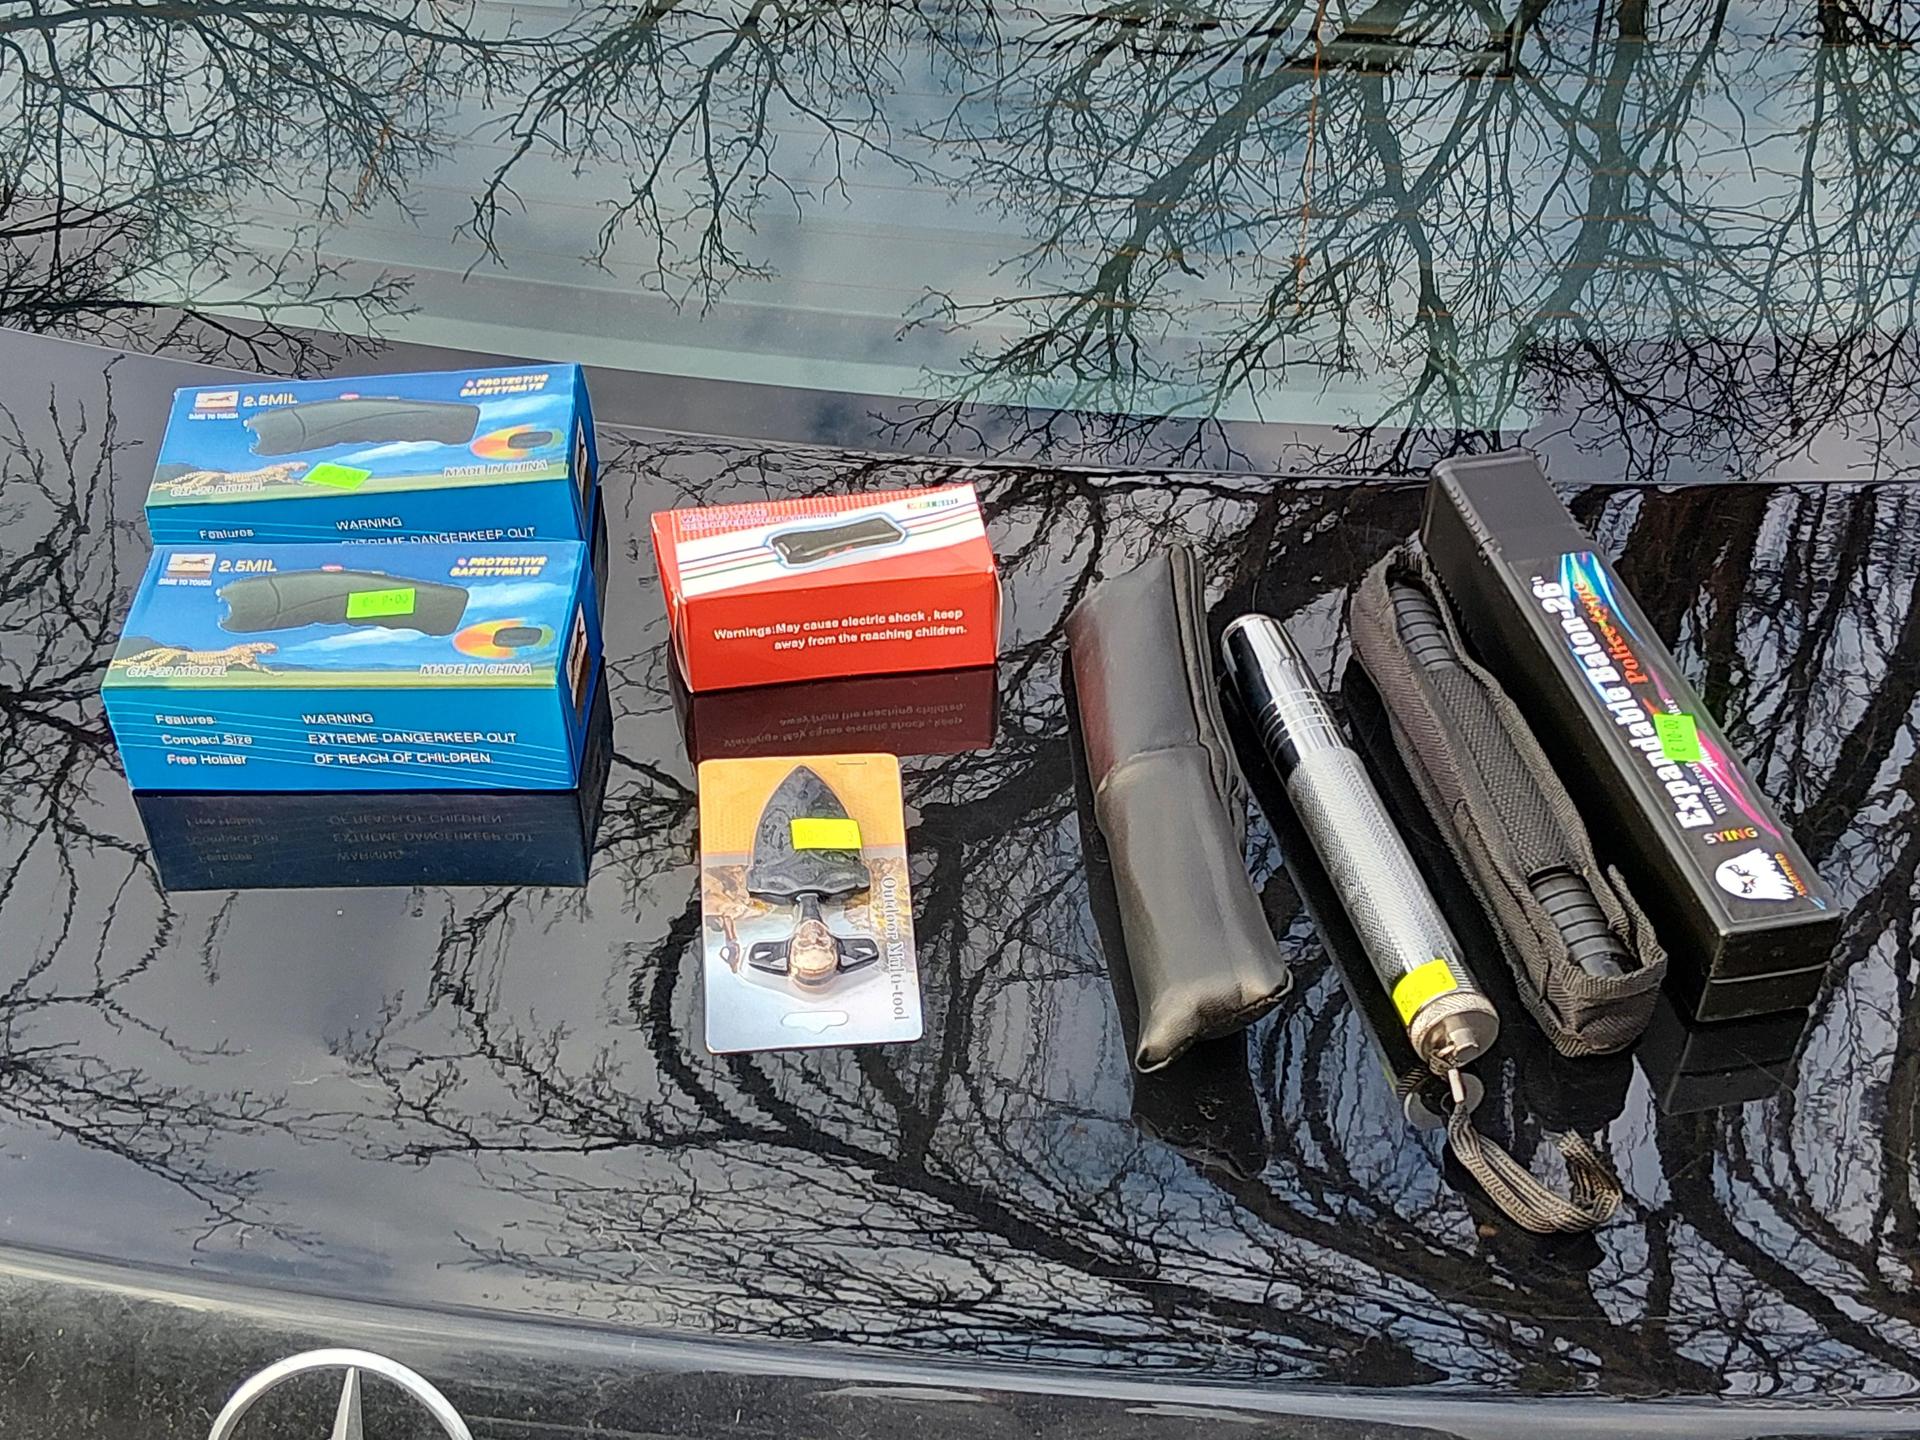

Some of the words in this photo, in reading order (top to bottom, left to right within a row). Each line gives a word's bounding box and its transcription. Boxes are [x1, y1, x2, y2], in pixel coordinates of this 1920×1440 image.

[336, 517, 402, 531] WARNING
[508, 527, 536, 539] OUT
[218, 559, 277, 573] 2.5MIL
[803, 619, 840, 632] cause
[841, 614, 886, 627] electric
[888, 611, 925, 623] shock
[934, 609, 963, 621] keep
[774, 638, 805, 651] away
[807, 634, 836, 647] from
[838, 633, 858, 644] the
[860, 628, 913, 642] reaching
[915, 624, 967, 638] children.
[174, 665, 228, 678] MODEL
[420, 663, 463, 676] MADE
[463, 663, 484, 676] IN
[485, 662, 532, 676] CHINA
[302, 713, 374, 724] WARNING
[161, 734, 221, 746] Compact
[222, 733, 252, 745] Size
[308, 732, 378, 745] EXTREME
[382, 731, 484, 743] DANGERKEEP
[486, 732, 517, 743] OUT
[166, 753, 197, 765] Free
[200, 754, 248, 765] Holster
[314, 752, 335, 765] OF
[338, 752, 390, 765] REACH
[392, 752, 413, 764] OF
[1606, 684, 1714, 829] Expandable
[1703, 785, 1728, 815] With
[1702, 826, 1759, 845] SYING
[881, 876, 899, 939] Outdoor
[887, 941, 910, 1021] Multi-tool
